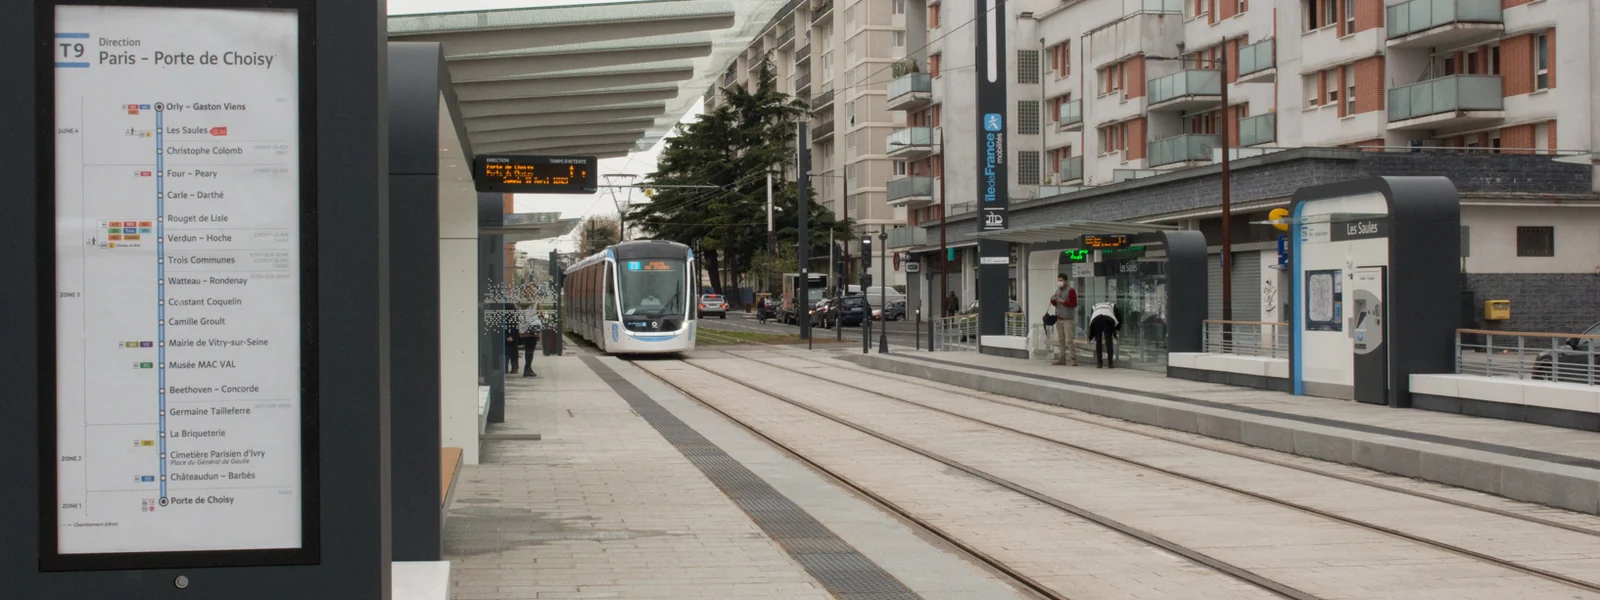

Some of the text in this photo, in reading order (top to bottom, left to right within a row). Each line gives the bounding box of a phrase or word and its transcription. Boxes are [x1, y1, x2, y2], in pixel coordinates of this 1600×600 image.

[99, 38, 140, 46] Direction
[60, 43, 84, 58] T9
[100, 51, 136, 65] Paris
[154, 51, 195, 65] Porte
[200, 51, 218, 65] de
[223, 52, 274, 68] Choisy
[166, 103, 183, 112] Orly
[193, 103, 222, 111] Gaston
[182, 126, 208, 134] Saules
[167, 146, 243, 156] Christophe Colomb
[985, 133, 995, 202] îledeFrance
[195, 170, 217, 179] Peary
[197, 191, 224, 199] Darthé
[168, 214, 196, 224] Rouget
[211, 214, 228, 222] Lisle
[1347, 221, 1378, 235] Les Saules
[210, 277, 248, 287] Rondenay
[207, 298, 242, 308] Coquelin
[169, 317, 198, 325] Camille
[169, 339, 194, 347] Mairie
[208, 338, 268, 348] Vitry-sur-Seine
[169, 360, 196, 369] Musée
[170, 386, 212, 394] Beethoven
[221, 385, 259, 393] Concorde
[182, 429, 225, 438] Briqueterie
[170, 450, 208, 459] Cimetière
[243, 450, 265, 459] d'Ivry
[171, 472, 219, 481] Châteaudun
[228, 472, 255, 480] Barbès
[207, 496, 234, 505] Choisy
